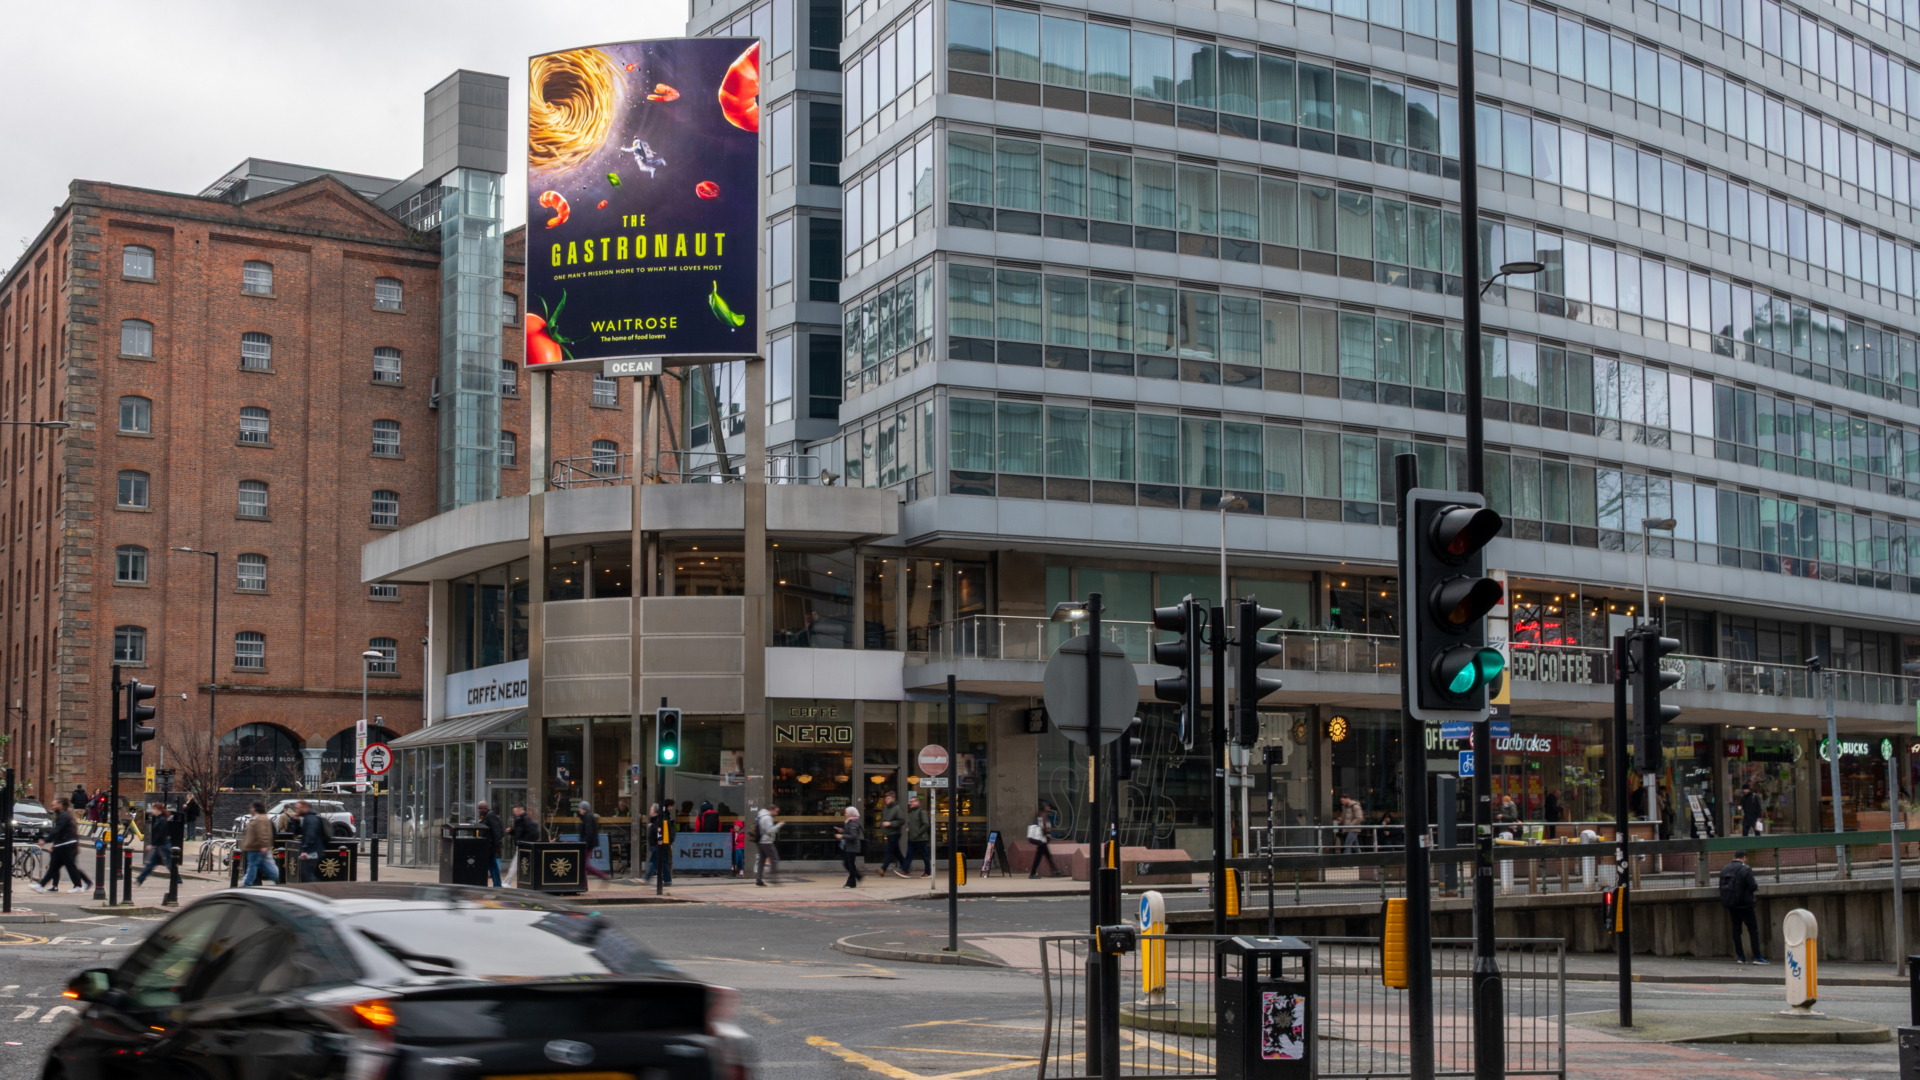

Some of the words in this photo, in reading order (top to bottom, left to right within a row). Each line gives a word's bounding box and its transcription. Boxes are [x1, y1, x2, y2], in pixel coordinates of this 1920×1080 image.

[622, 214, 646, 228] THE
[551, 232, 726, 267] GASTRONAUT
[567, 271, 586, 279] MAN'S
[588, 269, 614, 277] MISSION
[591, 317, 677, 332] WAITROSE
[612, 361, 653, 373] OCEAN
[1540, 653, 1592, 684] COFFEE
[467, 678, 497, 706] CAFFÈ
[498, 679, 528, 701] NERO
[789, 704, 839, 718] CAFFÈ
[775, 724, 853, 743] NERO
[1496, 733, 1551, 752] Ladbrokes
[1842, 742, 1869, 755] BUCKS
[680, 848, 724, 859] NERO
